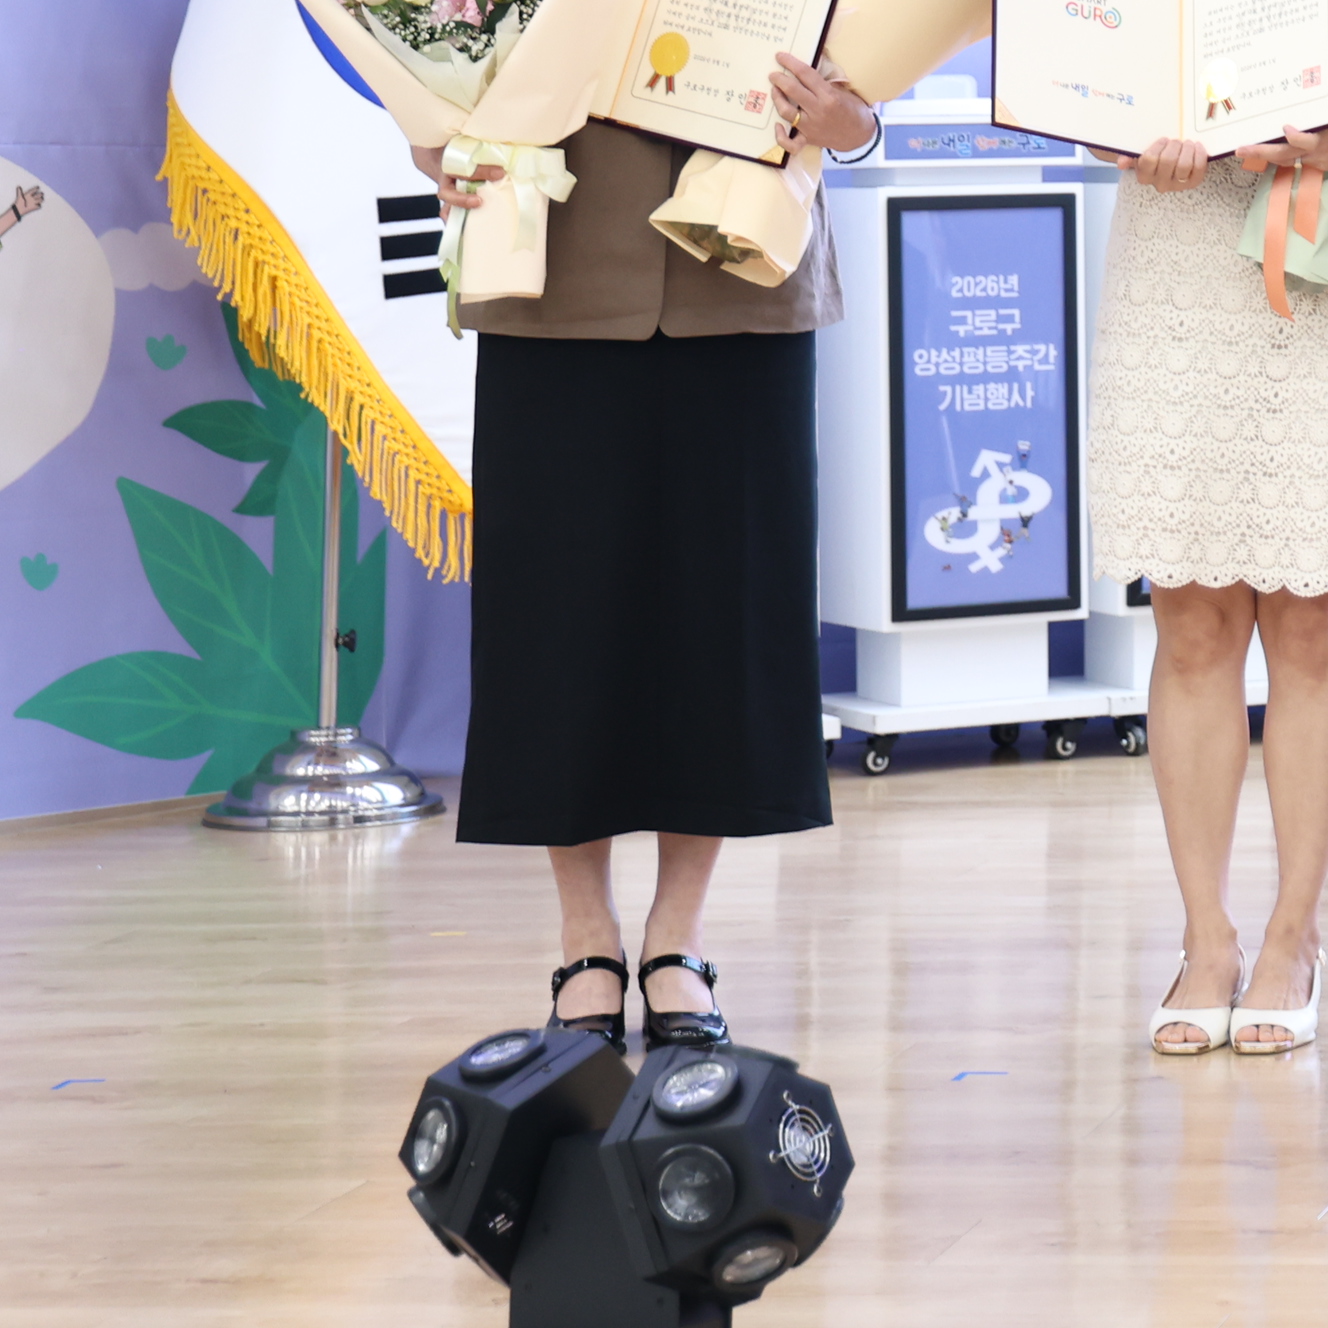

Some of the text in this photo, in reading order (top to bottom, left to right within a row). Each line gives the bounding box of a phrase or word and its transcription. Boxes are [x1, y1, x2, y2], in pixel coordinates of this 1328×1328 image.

[1065, 1, 1122, 29] GURO
[941, 133, 971, 156] 내일
[951, 274, 1020, 298] 2026년
[949, 308, 1021, 338] 구로구
[913, 342, 1058, 376] 양성평등주간
[938, 381, 1035, 412] 기념행사
